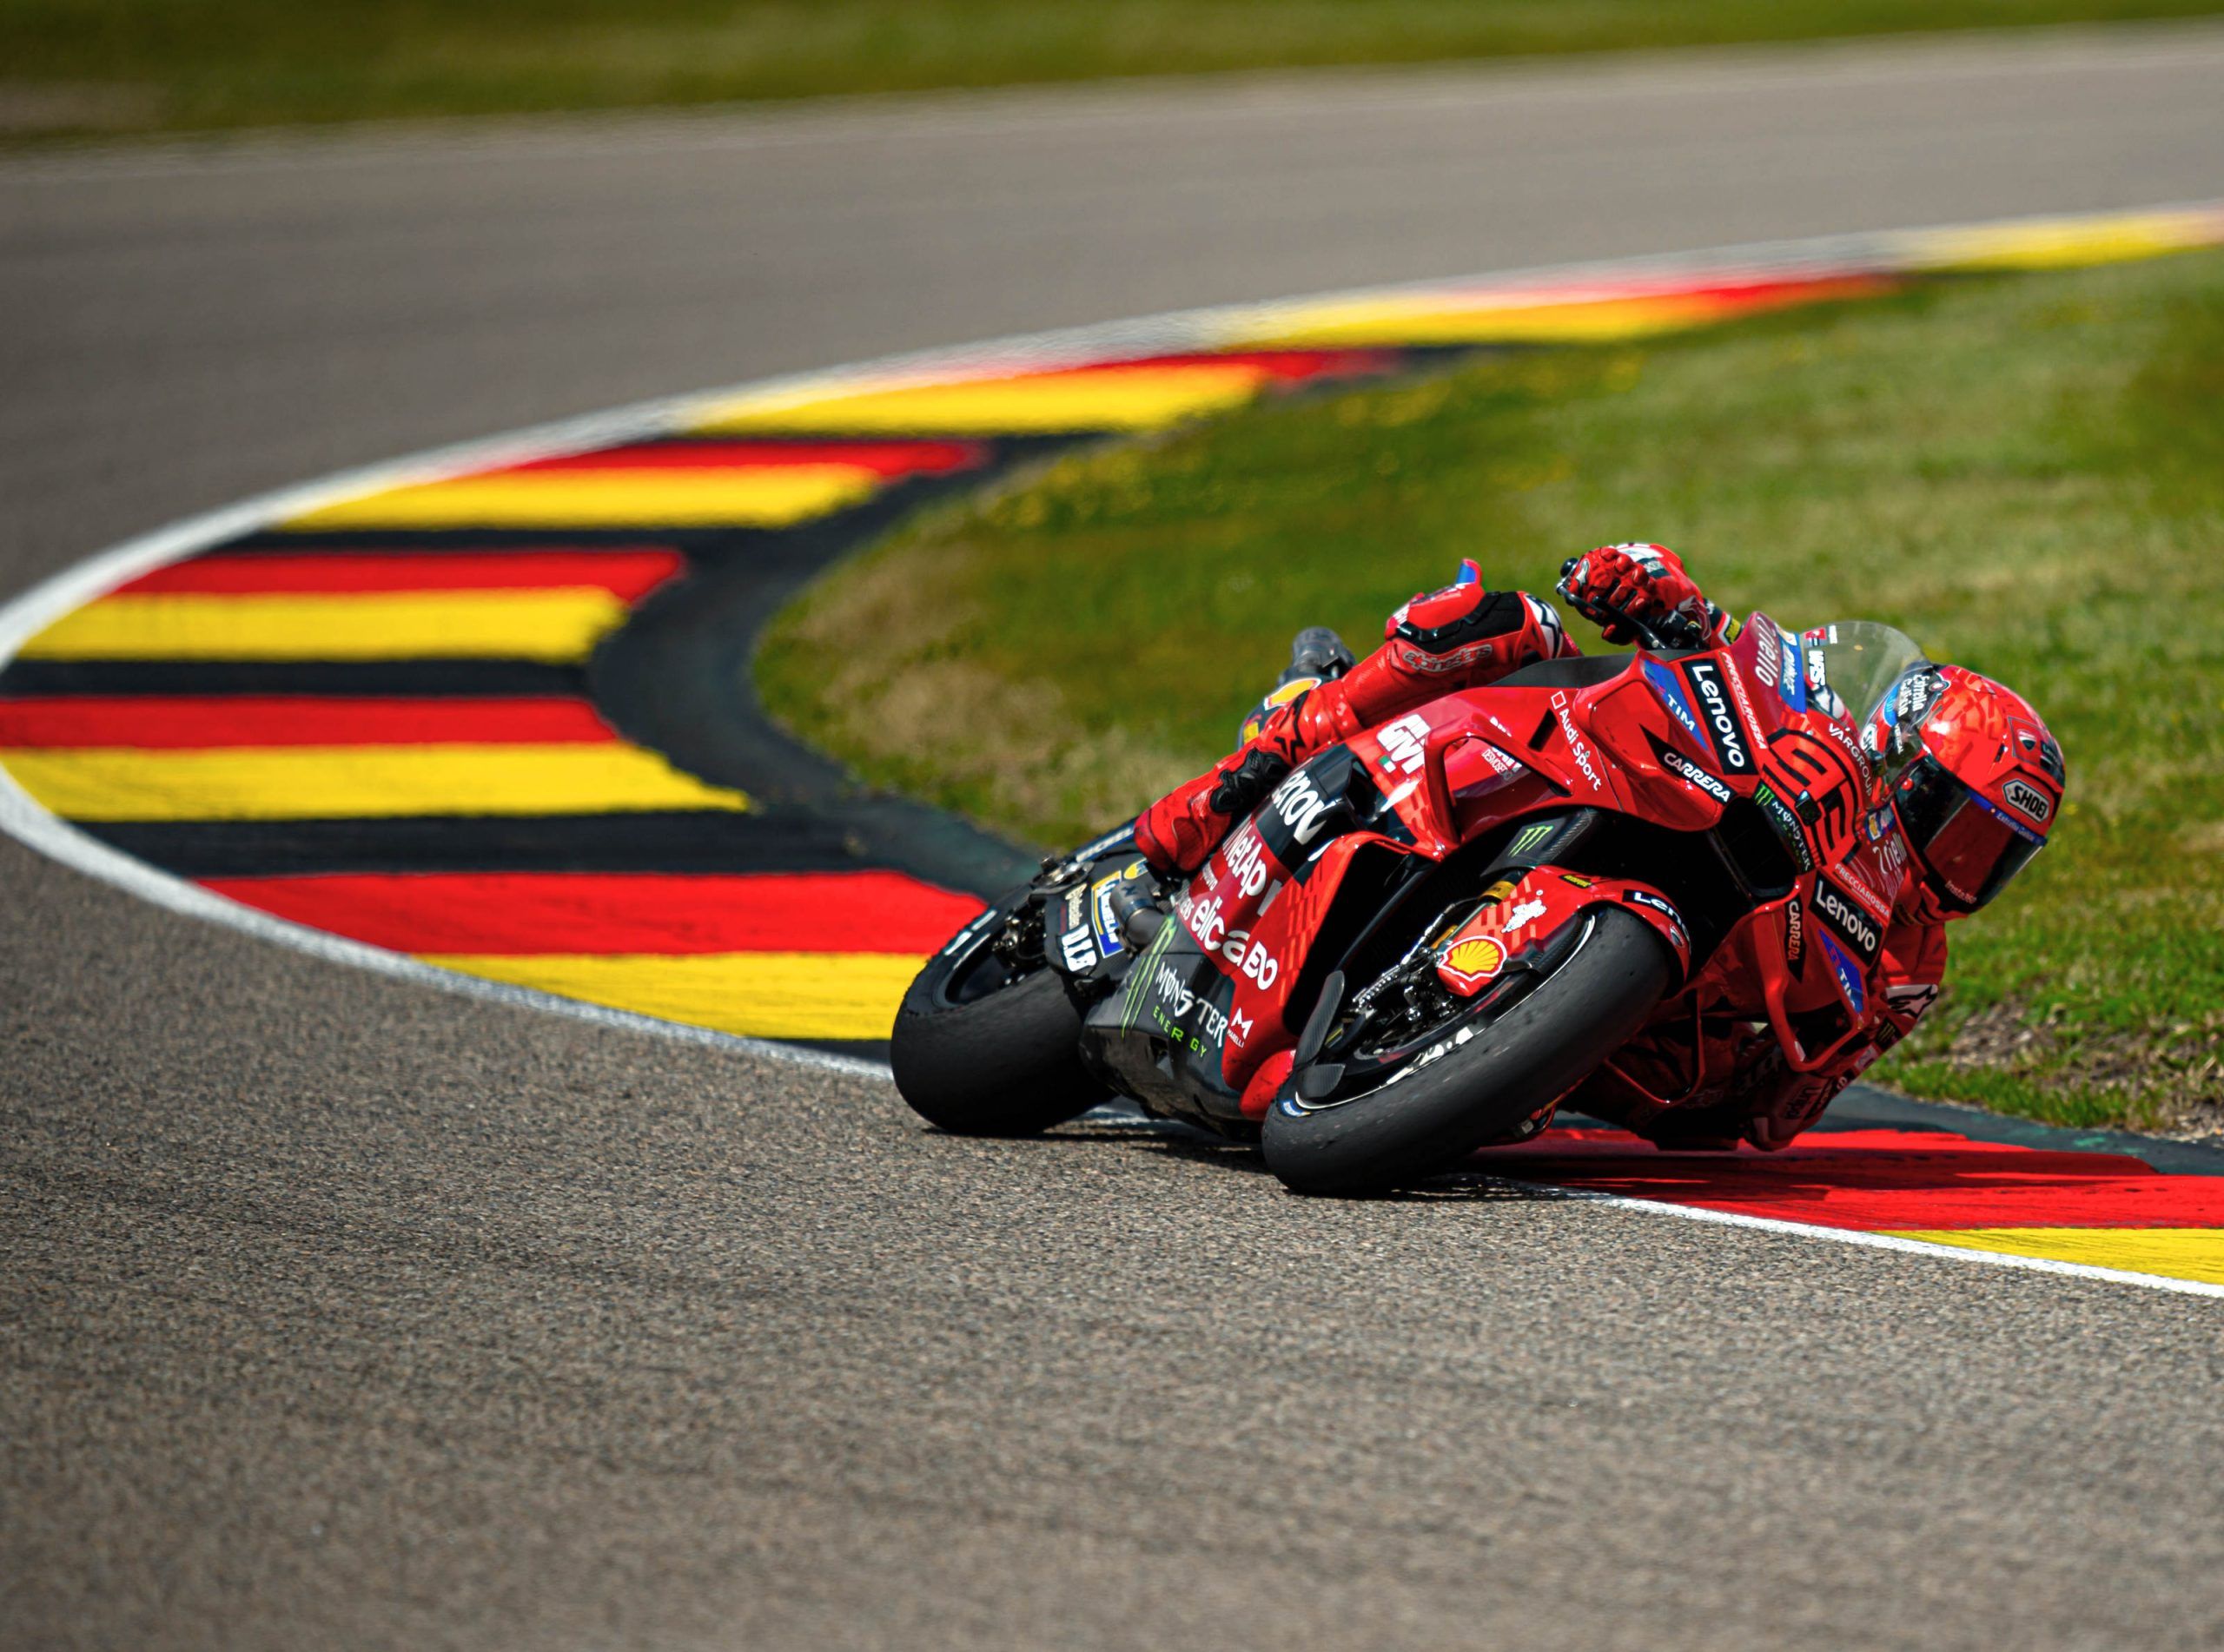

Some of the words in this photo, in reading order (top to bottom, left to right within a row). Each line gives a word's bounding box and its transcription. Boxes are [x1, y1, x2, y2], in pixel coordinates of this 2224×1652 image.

[1666, 694, 1696, 732] TIM
[1691, 664, 1745, 768] Lenovo
[1559, 708, 1579, 748] Audi
[1573, 741, 1603, 792] Sport
[1663, 751, 1731, 803] CARRERA
[2009, 785, 2048, 819] SHOEI
[1771, 801, 1812, 871] MONSTER
[1816, 880, 1876, 952] Lenovo
[1834, 862, 1890, 917] FRECCIAROSSA
[1788, 901, 1802, 961] CARRERA
[1153, 1005, 1208, 1059] ENERGY
[1155, 961, 1229, 1048] MONSTER
[1227, 1029, 1245, 1049] MARELLI
